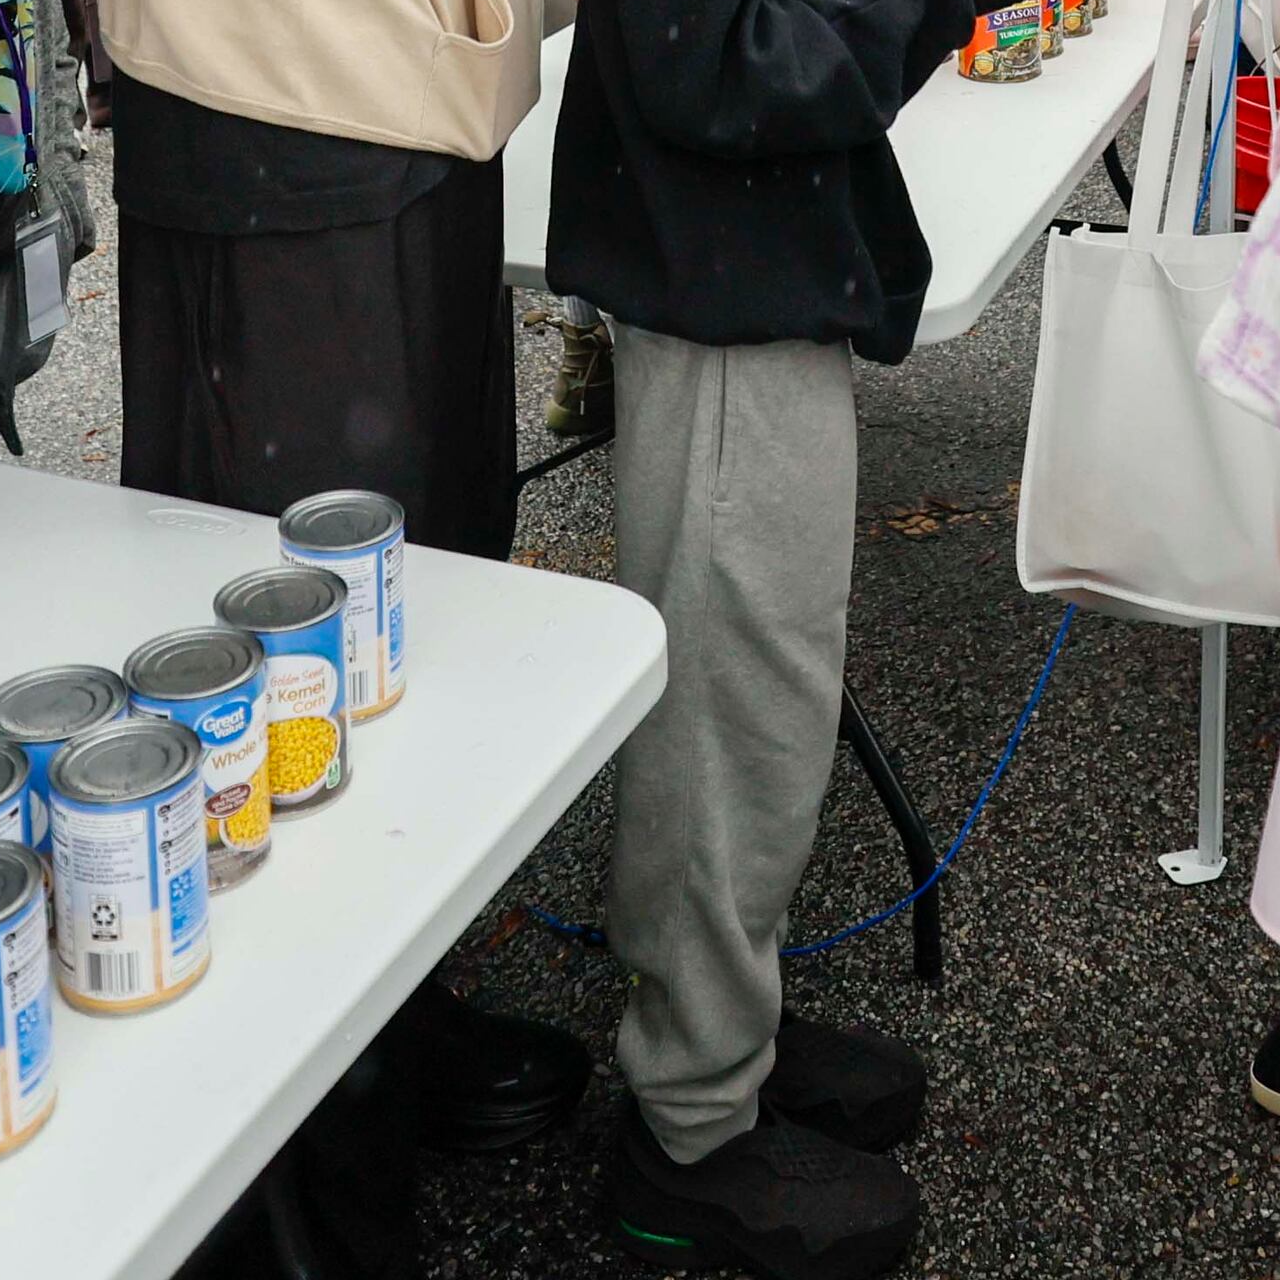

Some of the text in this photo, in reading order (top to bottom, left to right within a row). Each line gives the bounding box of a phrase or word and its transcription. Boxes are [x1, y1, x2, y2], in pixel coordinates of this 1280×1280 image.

[993, 6, 1040, 26] SEASONE
[277, 678, 326, 704] Kernel
[293, 695, 326, 714] Corn
[202, 705, 245, 732] Great
[211, 740, 257, 770] Whole
